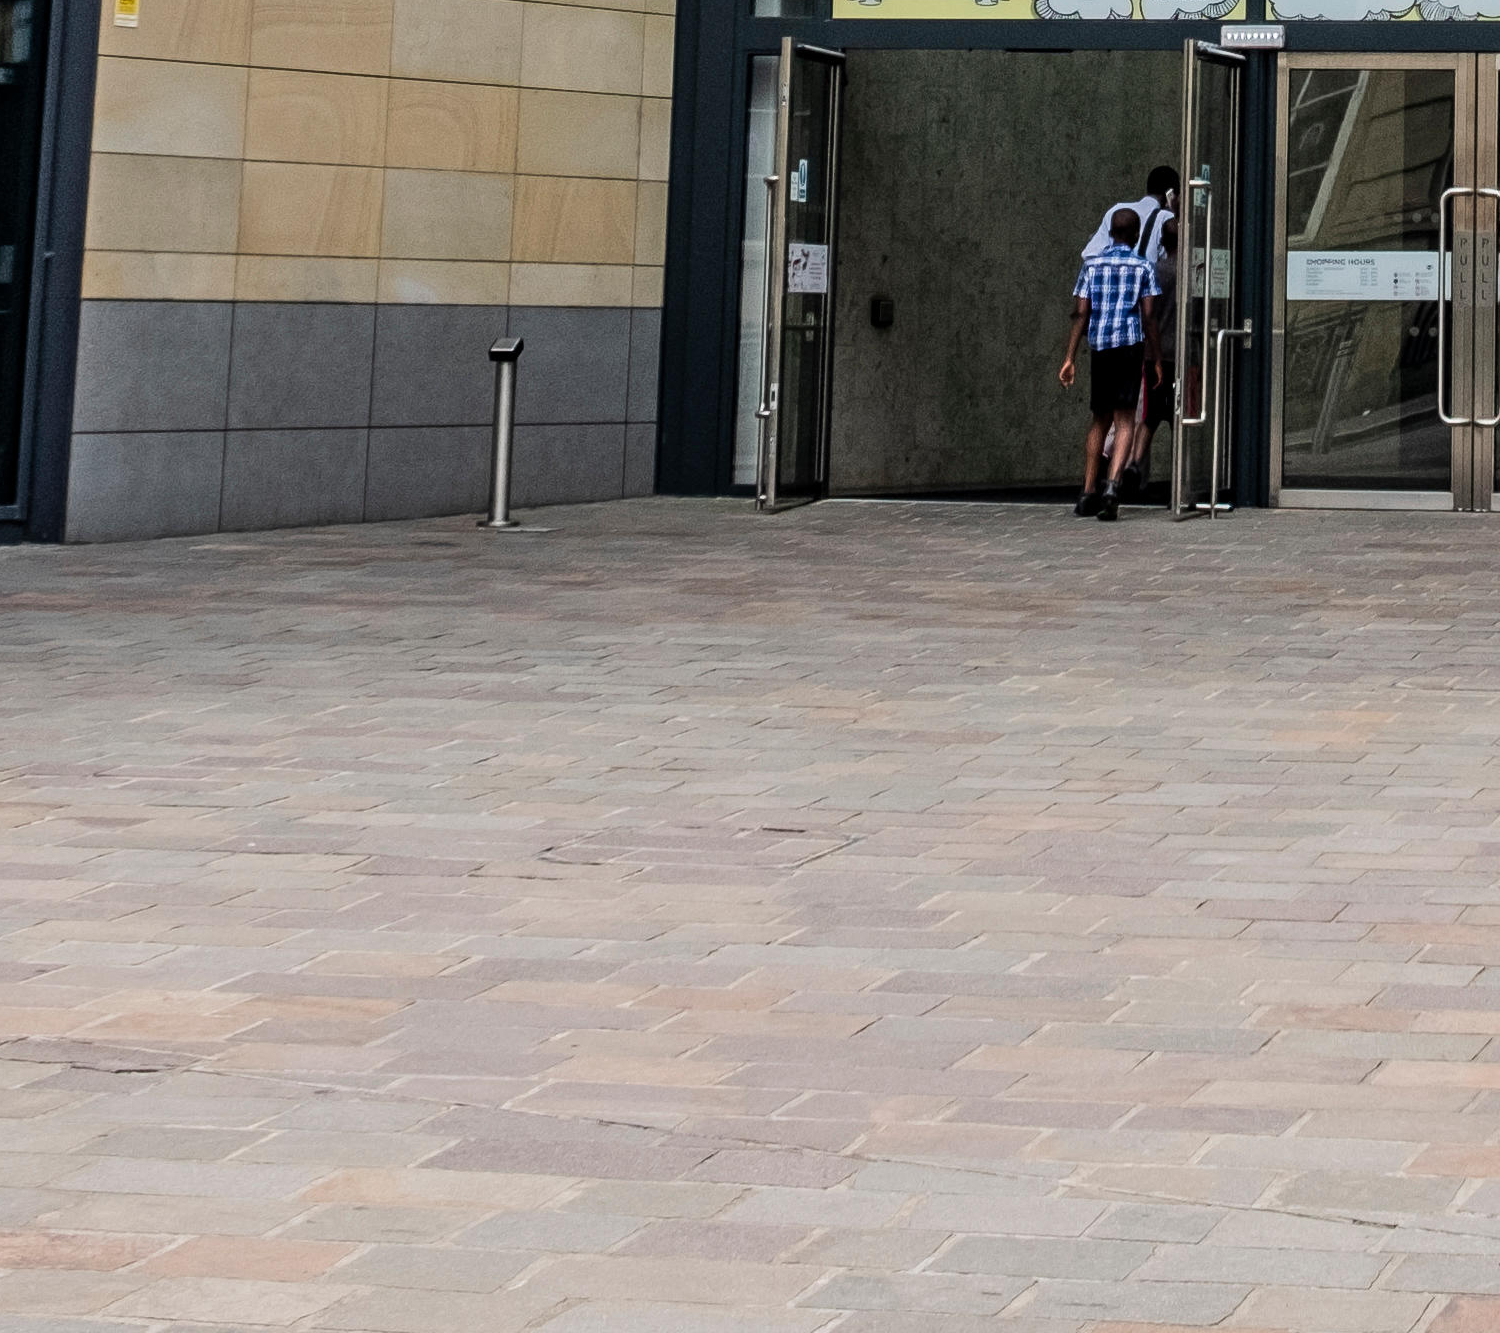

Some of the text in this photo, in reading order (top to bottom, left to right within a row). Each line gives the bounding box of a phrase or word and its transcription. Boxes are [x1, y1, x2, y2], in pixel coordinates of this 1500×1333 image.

[1348, 258, 1376, 267] HOURS
[1459, 238, 1468, 301] PULL
[1481, 238, 1490, 301] PULL
